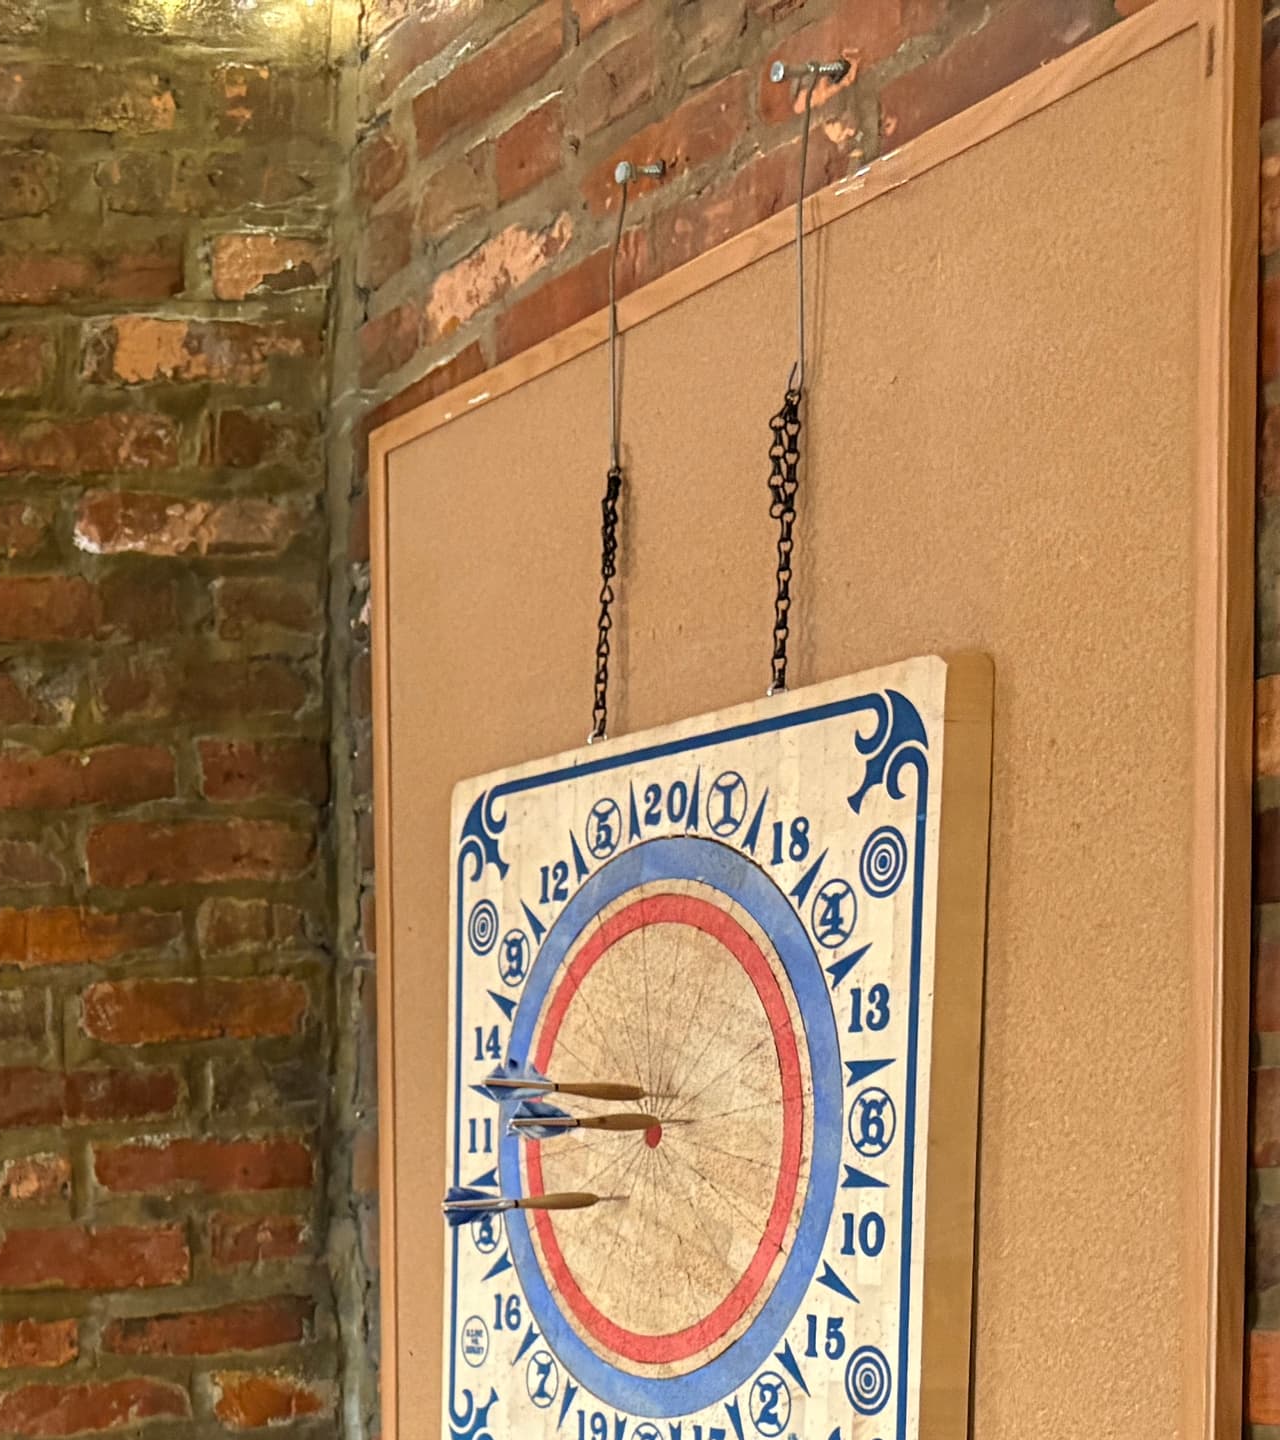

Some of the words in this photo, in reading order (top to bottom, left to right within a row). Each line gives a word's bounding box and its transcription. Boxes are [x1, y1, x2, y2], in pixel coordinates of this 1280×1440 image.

[644, 780, 688, 825] 20
[771, 816, 810, 865] 18
[539, 860, 569, 904] 12
[848, 983, 890, 1033] 13
[474, 1025, 502, 1060] 14
[468, 1118, 493, 1153] 11
[841, 1211, 885, 1257] 10
[493, 1293, 521, 1331] 16
[805, 1314, 845, 1360] 15
